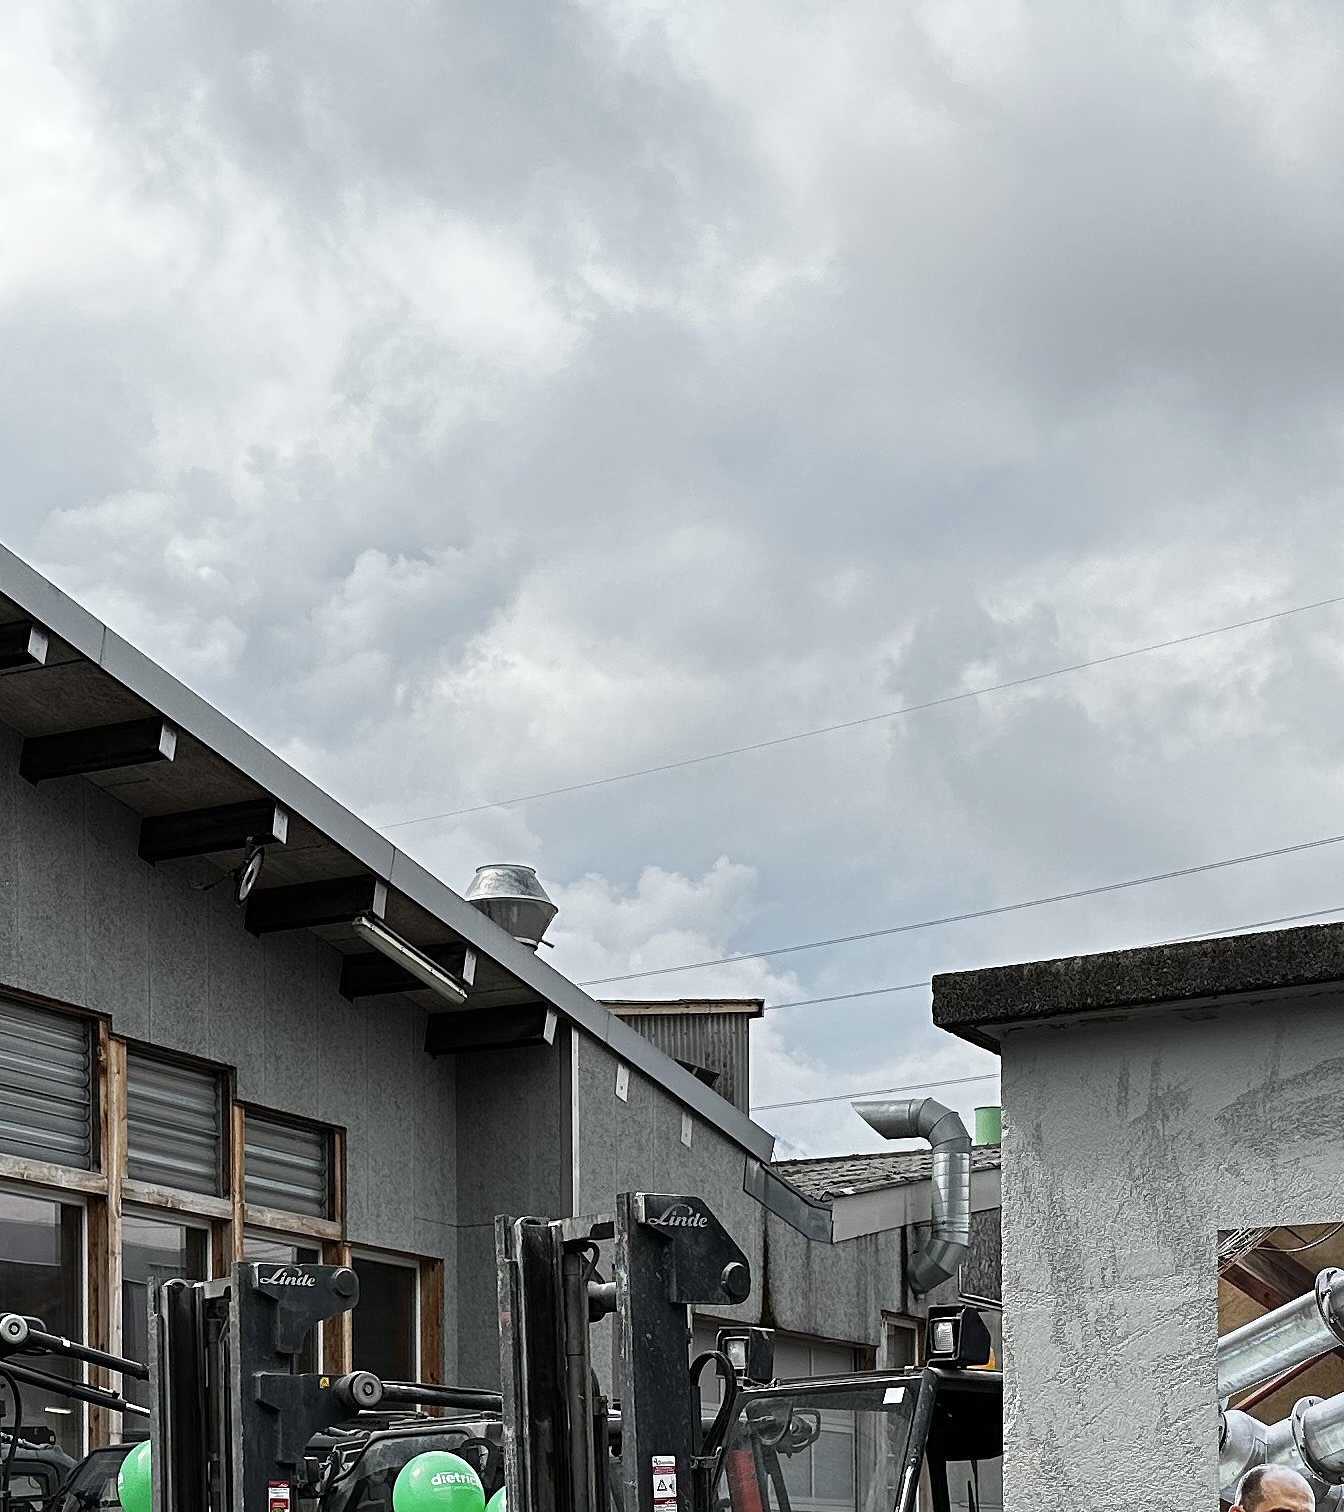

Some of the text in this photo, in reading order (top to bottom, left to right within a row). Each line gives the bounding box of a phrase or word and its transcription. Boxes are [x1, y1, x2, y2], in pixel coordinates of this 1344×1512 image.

[647, 1203, 708, 1228] Linde
[259, 1267, 316, 1287] Linde
[431, 1471, 480, 1486] dietric
